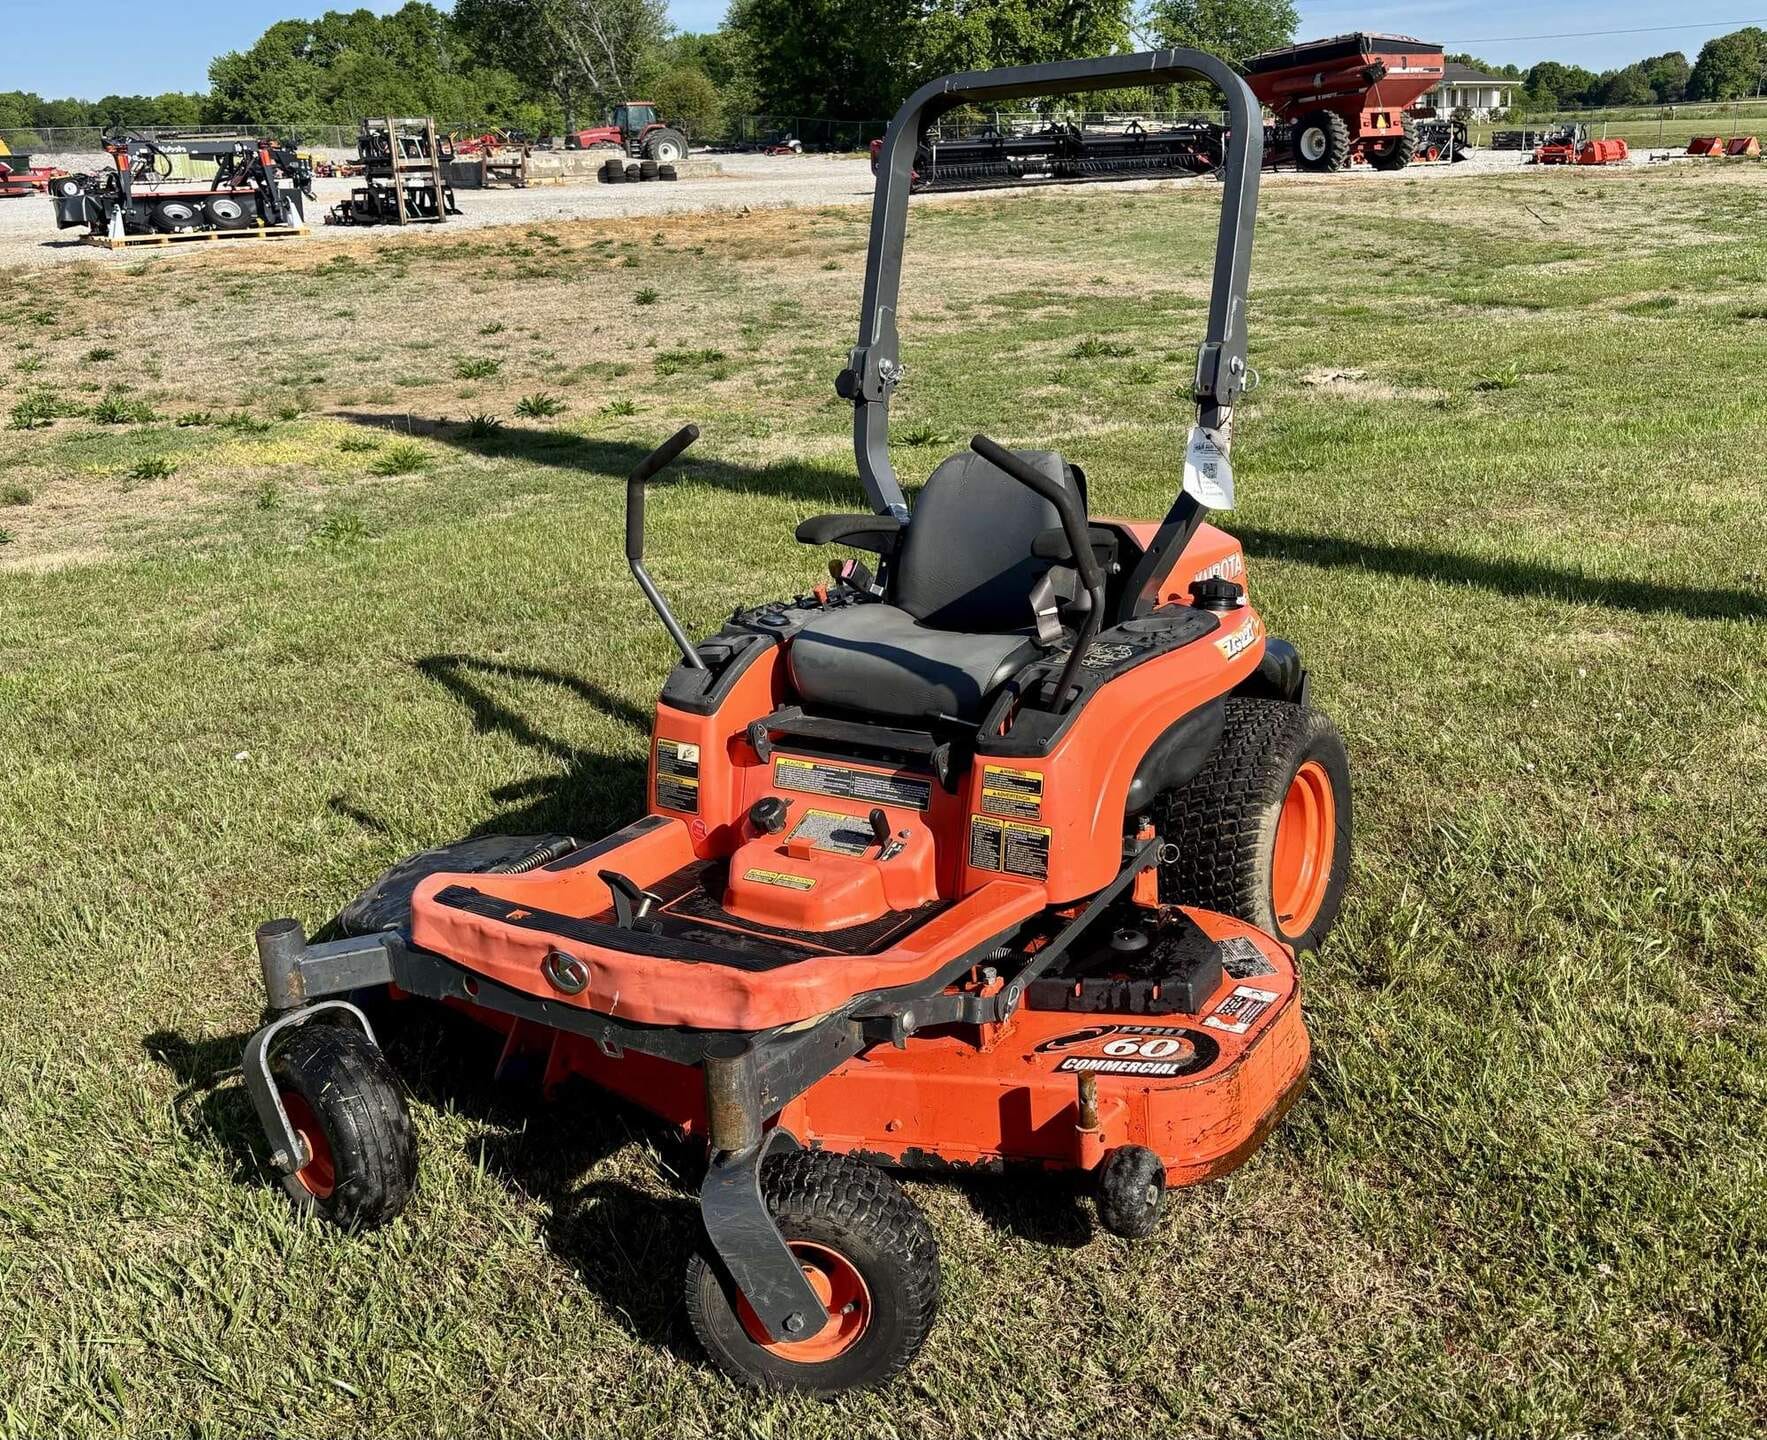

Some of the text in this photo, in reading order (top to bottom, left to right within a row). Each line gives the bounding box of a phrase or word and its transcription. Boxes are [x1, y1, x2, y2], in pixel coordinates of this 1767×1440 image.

[1119, 1025, 1187, 1036] PRO
[1103, 1037, 1180, 1058] 60
[1061, 1058, 1180, 1075] COMMERCIAL
